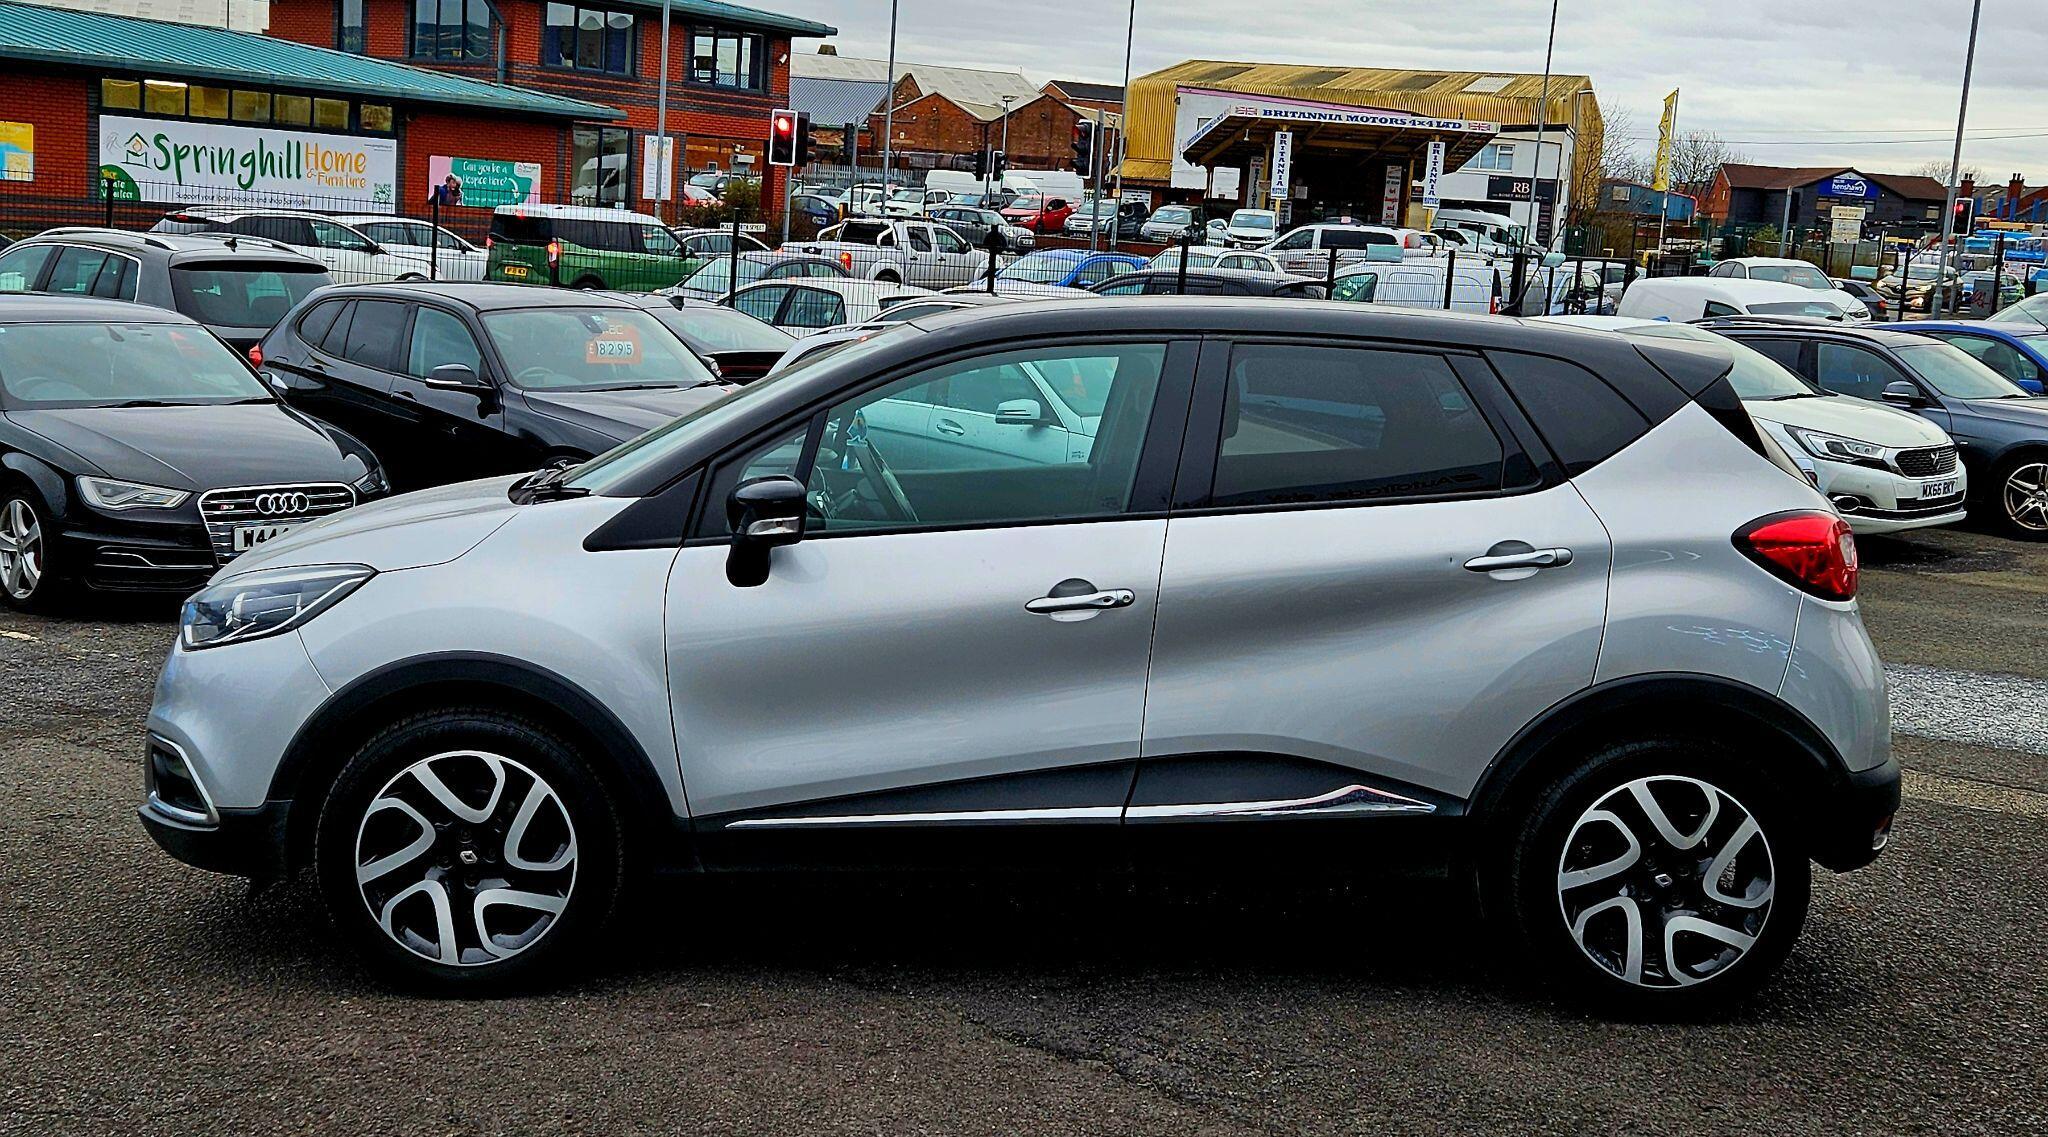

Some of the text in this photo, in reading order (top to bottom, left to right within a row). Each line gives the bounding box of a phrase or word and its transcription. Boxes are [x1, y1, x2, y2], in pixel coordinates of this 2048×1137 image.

[1263, 109, 1342, 122] BRITANNIA
[1346, 115, 1407, 126] MOTORS
[1436, 121, 1462, 129] LTD
[153, 133, 301, 190] Springhill
[305, 142, 367, 174] Home
[1276, 133, 1288, 187] BRITANNIA
[306, 168, 366, 188] & Furniture
[463, 161, 476, 172] Can
[478, 163, 491, 176] you
[1428, 143, 1440, 196] BRITANNIA
[463, 174, 508, 187] Hospice Here?
[1512, 182, 1530, 194] RB
[1832, 183, 1863, 191] henshaws
[599, 343, 633, 356] 8295
